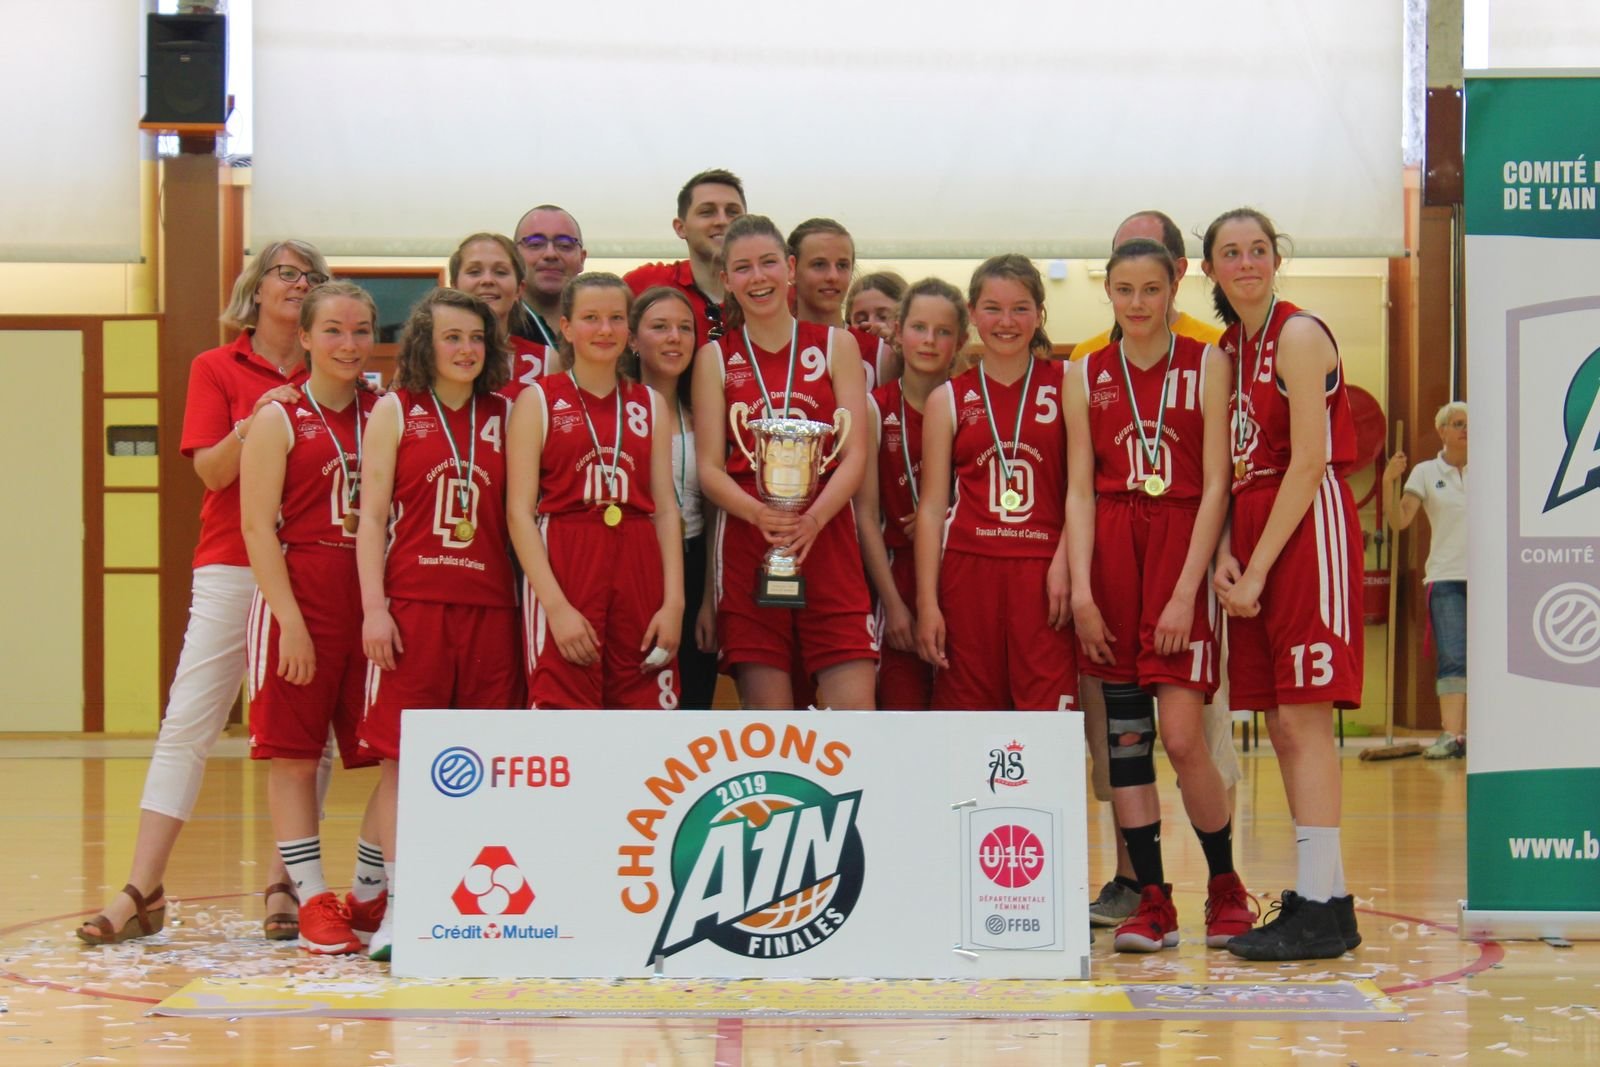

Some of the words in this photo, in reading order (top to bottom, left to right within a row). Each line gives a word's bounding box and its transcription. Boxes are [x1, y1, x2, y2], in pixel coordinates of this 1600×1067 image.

[1503, 154, 1587, 184] COMITÉ
[1503, 187, 1532, 210] DE
[1539, 187, 1596, 210] L'AIN
[519, 354, 543, 385] 2
[800, 346, 826, 382] 9
[1034, 385, 1058, 424] 5
[1165, 368, 1197, 410] 11
[480, 416, 501, 453] 4
[625, 401, 649, 438] 8
[1520, 545, 1594, 563] COMITÉ
[1290, 642, 1333, 688] 13
[657, 669, 678, 710] 8
[491, 756, 571, 788] FFBB
[716, 774, 767, 805] 2019
[617, 722, 852, 914] CHAMPIONS
[983, 846, 1039, 868] U15
[979, 894, 1046, 903] DÉPARTEMENTALE
[431, 925, 482, 940] Crédit
[503, 925, 558, 940] Mutuel
[748, 907, 845, 956] FINALES
[1007, 918, 1041, 932] FFBB
